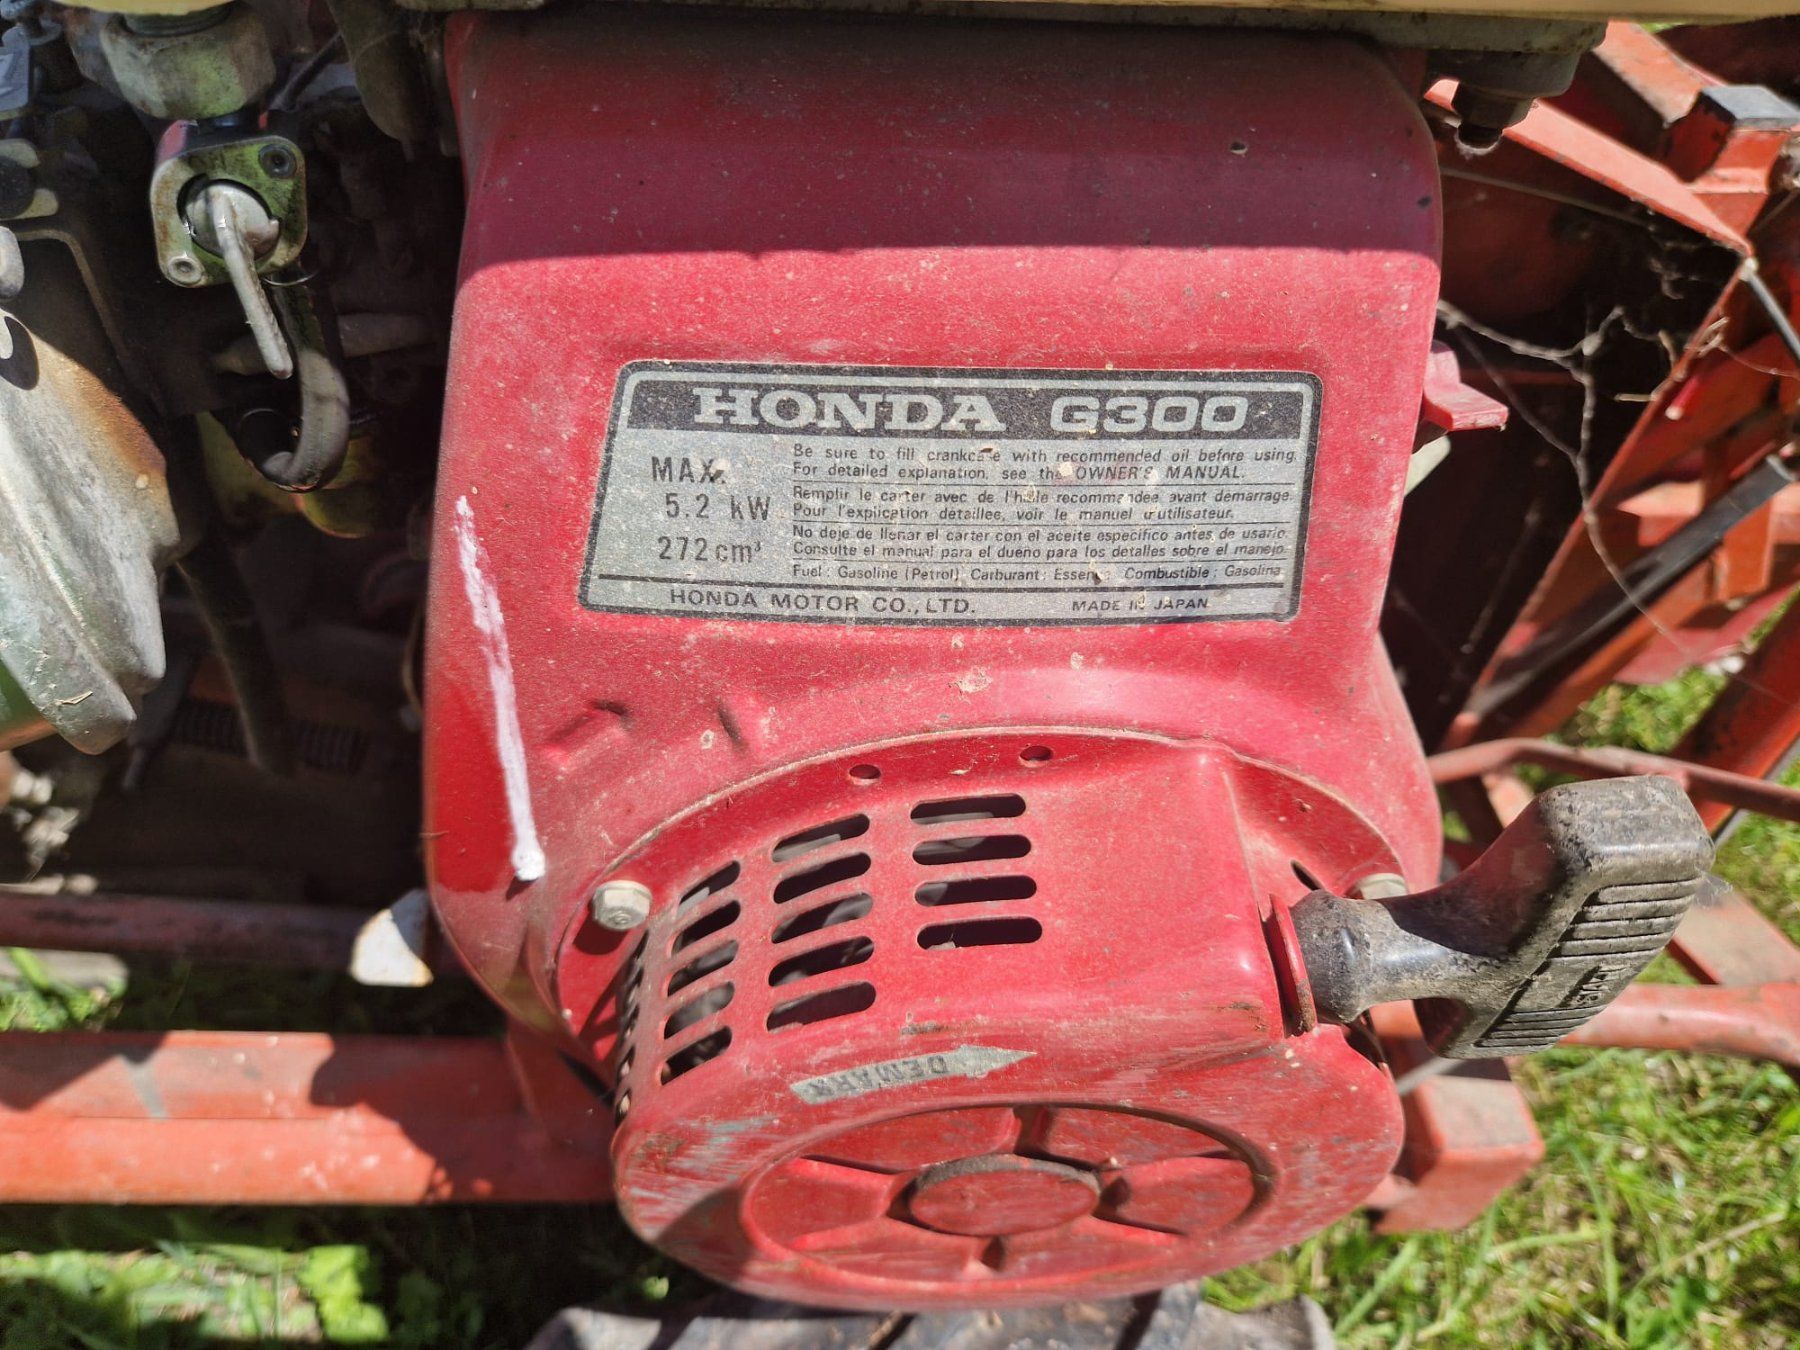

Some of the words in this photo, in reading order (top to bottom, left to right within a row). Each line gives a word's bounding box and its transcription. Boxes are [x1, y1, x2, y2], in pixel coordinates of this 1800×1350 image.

[693, 387, 1006, 432] HONDA
[1050, 395, 1249, 433] G300
[793, 443, 813, 458] Be
[826, 448, 857, 460] sure
[869, 448, 885, 460] to
[897, 447, 915, 460] fill
[1013, 448, 1047, 462] with
[1056, 449, 1161, 463] recommended
[1171, 449, 1189, 462] oil
[1198, 449, 1243, 462] before
[651, 456, 726, 486] MAX.
[793, 462, 817, 476] For
[828, 464, 888, 478] detailed
[1002, 470, 1027, 480] see
[1166, 466, 1245, 480] MANUAL.
[793, 486, 850, 503] Remplir
[859, 488, 872, 501] le
[880, 489, 926, 503] carter
[935, 493, 967, 503] avec
[978, 490, 995, 503] de
[1169, 492, 1207, 504] avant
[665, 493, 710, 521] 5.2
[730, 495, 770, 522] kW
[793, 503, 827, 517] Pour
[1016, 508, 1045, 521] voir
[1054, 507, 1068, 521] le
[1079, 507, 1133, 520] manuel
[792, 525, 813, 539] No
[820, 528, 850, 542] deje
[857, 528, 873, 540] de
[880, 528, 922, 541] llenar
[926, 529, 939, 541] el
[946, 531, 989, 542] carter
[995, 531, 1022, 542] con
[1028, 529, 1040, 542] el
[1047, 530, 1091, 542] aceite
[1097, 528, 1169, 545] especifico
[1219, 527, 1235, 540] de
[793, 541, 857, 556] Consulte
[863, 544, 875, 556] el
[882, 546, 934, 558] manual
[941, 548, 972, 560] para
[978, 546, 991, 558] el
[1047, 548, 1078, 561] para
[1084, 545, 1106, 558] los
[1112, 545, 1166, 558] detalles
[1172, 543, 1210, 557] sobre
[1216, 543, 1229, 556] el
[837, 566, 898, 580] Gasoline
[905, 568, 960, 582] (Petrol)
[1224, 563, 1281, 578] Gasolina
[671, 588, 757, 608] HONDA
[771, 591, 859, 612] MOTOR
[1071, 599, 1122, 613] MADE
[1153, 597, 1209, 612] JAPAN
